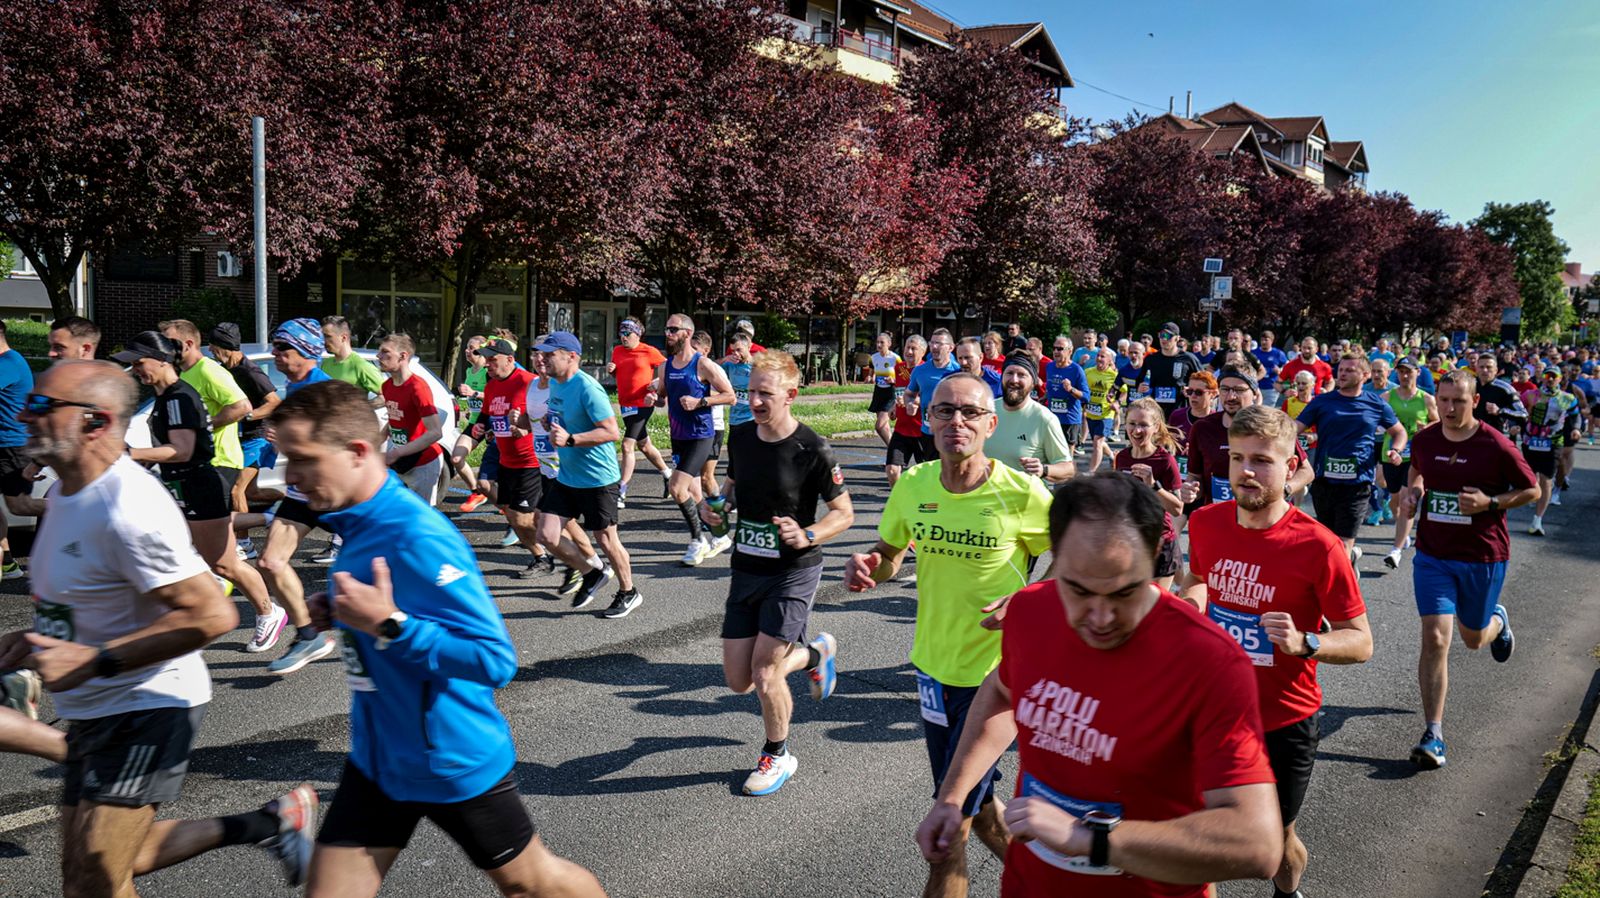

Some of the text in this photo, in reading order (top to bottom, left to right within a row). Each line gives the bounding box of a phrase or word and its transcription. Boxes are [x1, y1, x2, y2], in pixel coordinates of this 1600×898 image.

[492, 421, 506, 431] 133
[1326, 462, 1355, 473] 1302
[1221, 486, 1233, 500] 3
[1430, 498, 1464, 515] 132
[738, 528, 776, 549] 1263
[930, 524, 998, 548] Đurkin
[922, 545, 983, 560] ČAKOVEC
[1221, 559, 1261, 582] POLU
[1208, 572, 1276, 604] MARATON
[1219, 591, 1259, 609] ZRINSKIH
[1217, 621, 1260, 651] 95
[1038, 680, 1101, 725] POLU
[1016, 697, 1119, 762] MARATON
